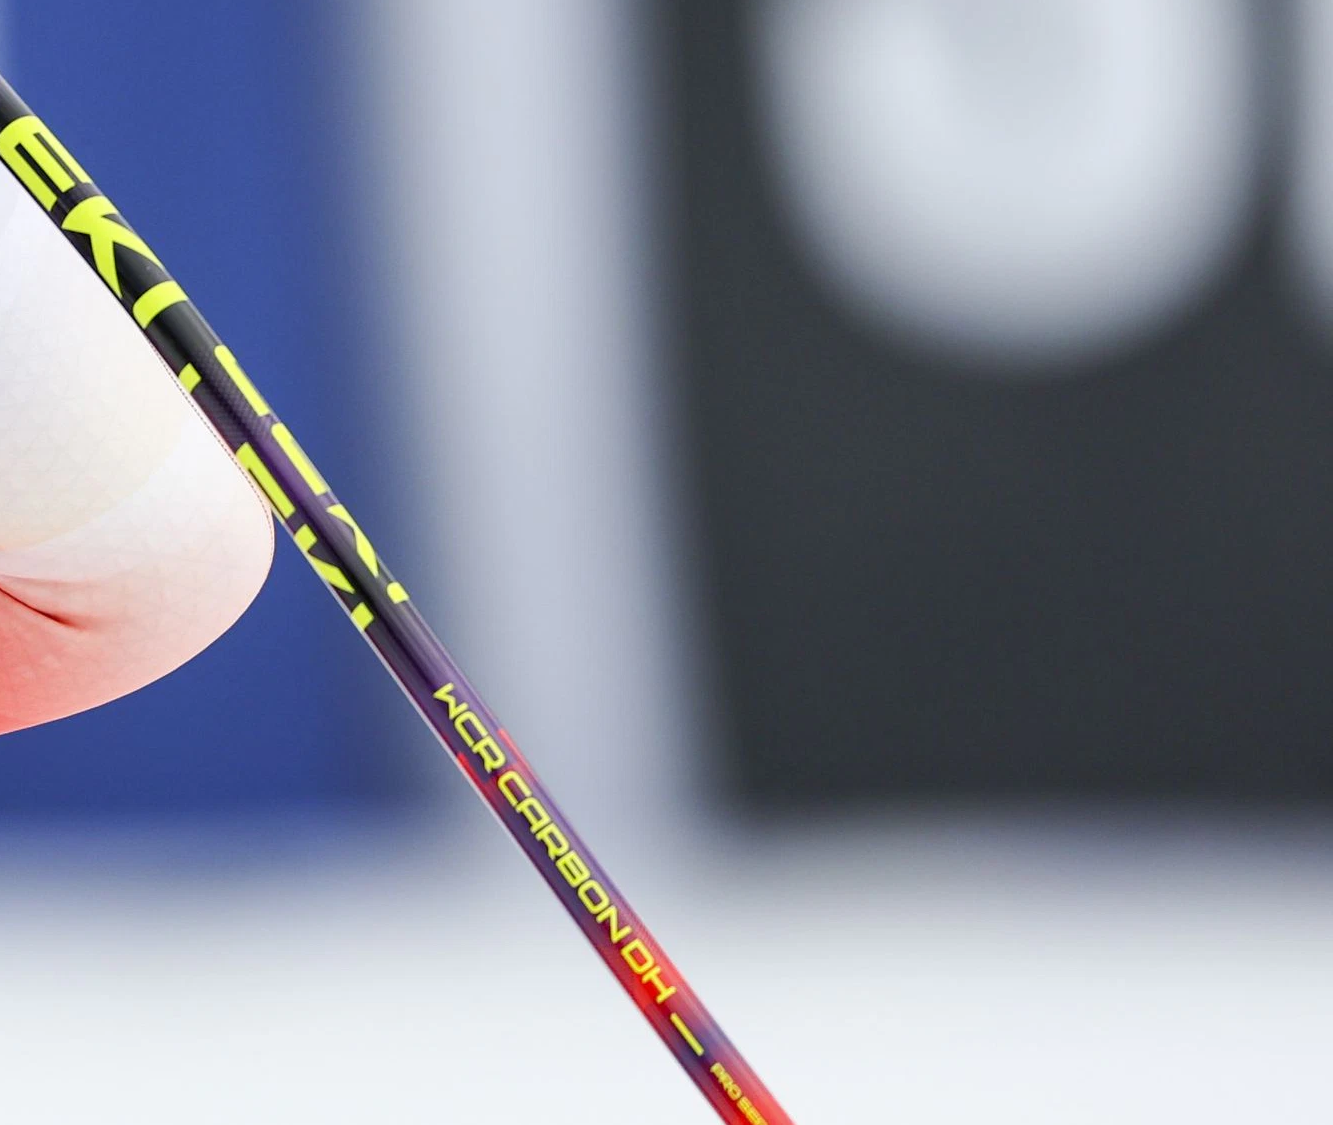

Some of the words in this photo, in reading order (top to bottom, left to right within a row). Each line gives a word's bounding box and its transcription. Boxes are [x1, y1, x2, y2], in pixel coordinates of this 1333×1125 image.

[433, 683, 506, 774] WCR
[497, 770, 632, 943] CARBON
[620, 938, 677, 1004] DH
